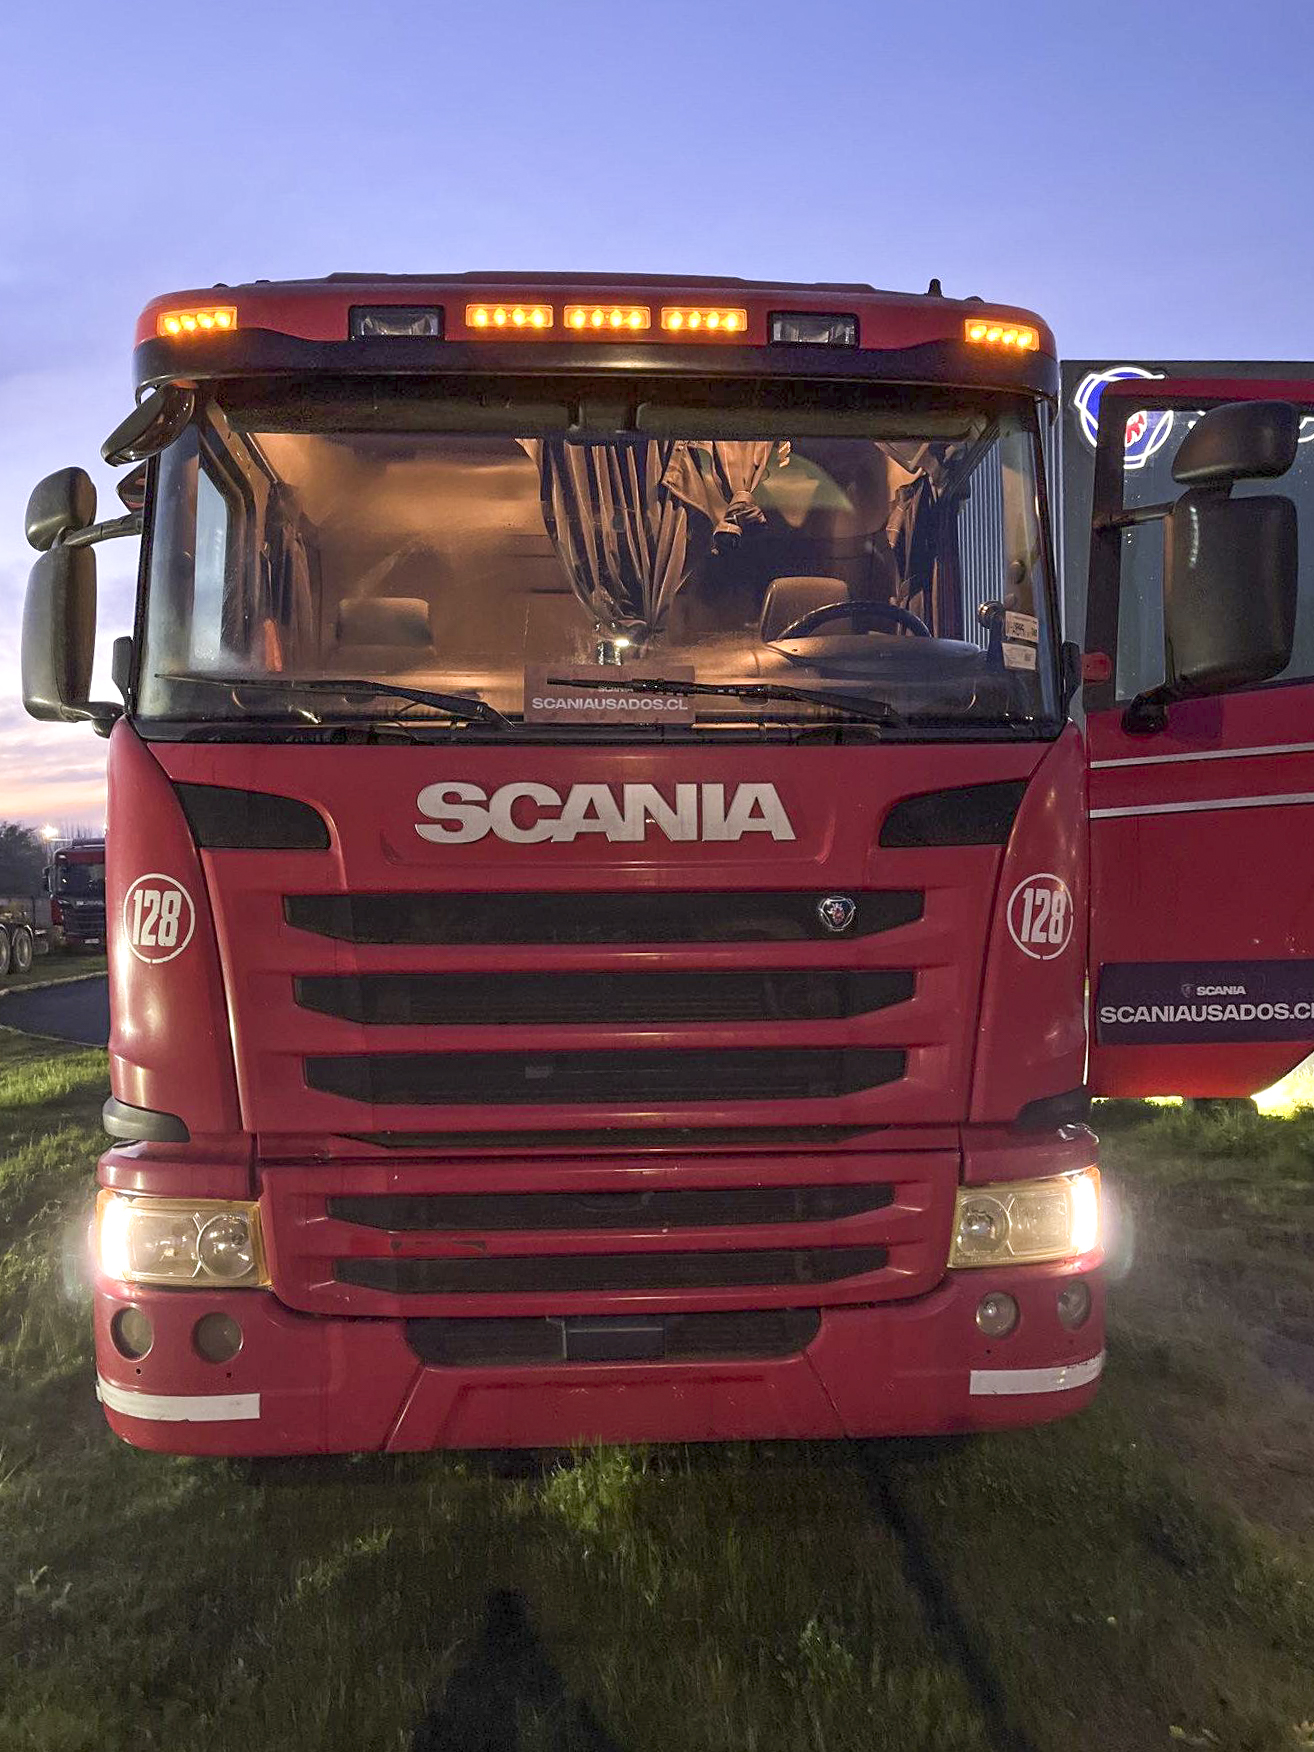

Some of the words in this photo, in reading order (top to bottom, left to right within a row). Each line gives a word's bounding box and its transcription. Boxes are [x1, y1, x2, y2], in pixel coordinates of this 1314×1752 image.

[532, 698, 688, 710] SCANIAUSADOS.CL
[415, 781, 797, 844] SCANIA
[132, 889, 182, 947] 128
[1020, 888, 1068, 944] 128
[1196, 985, 1246, 996] SCANIA
